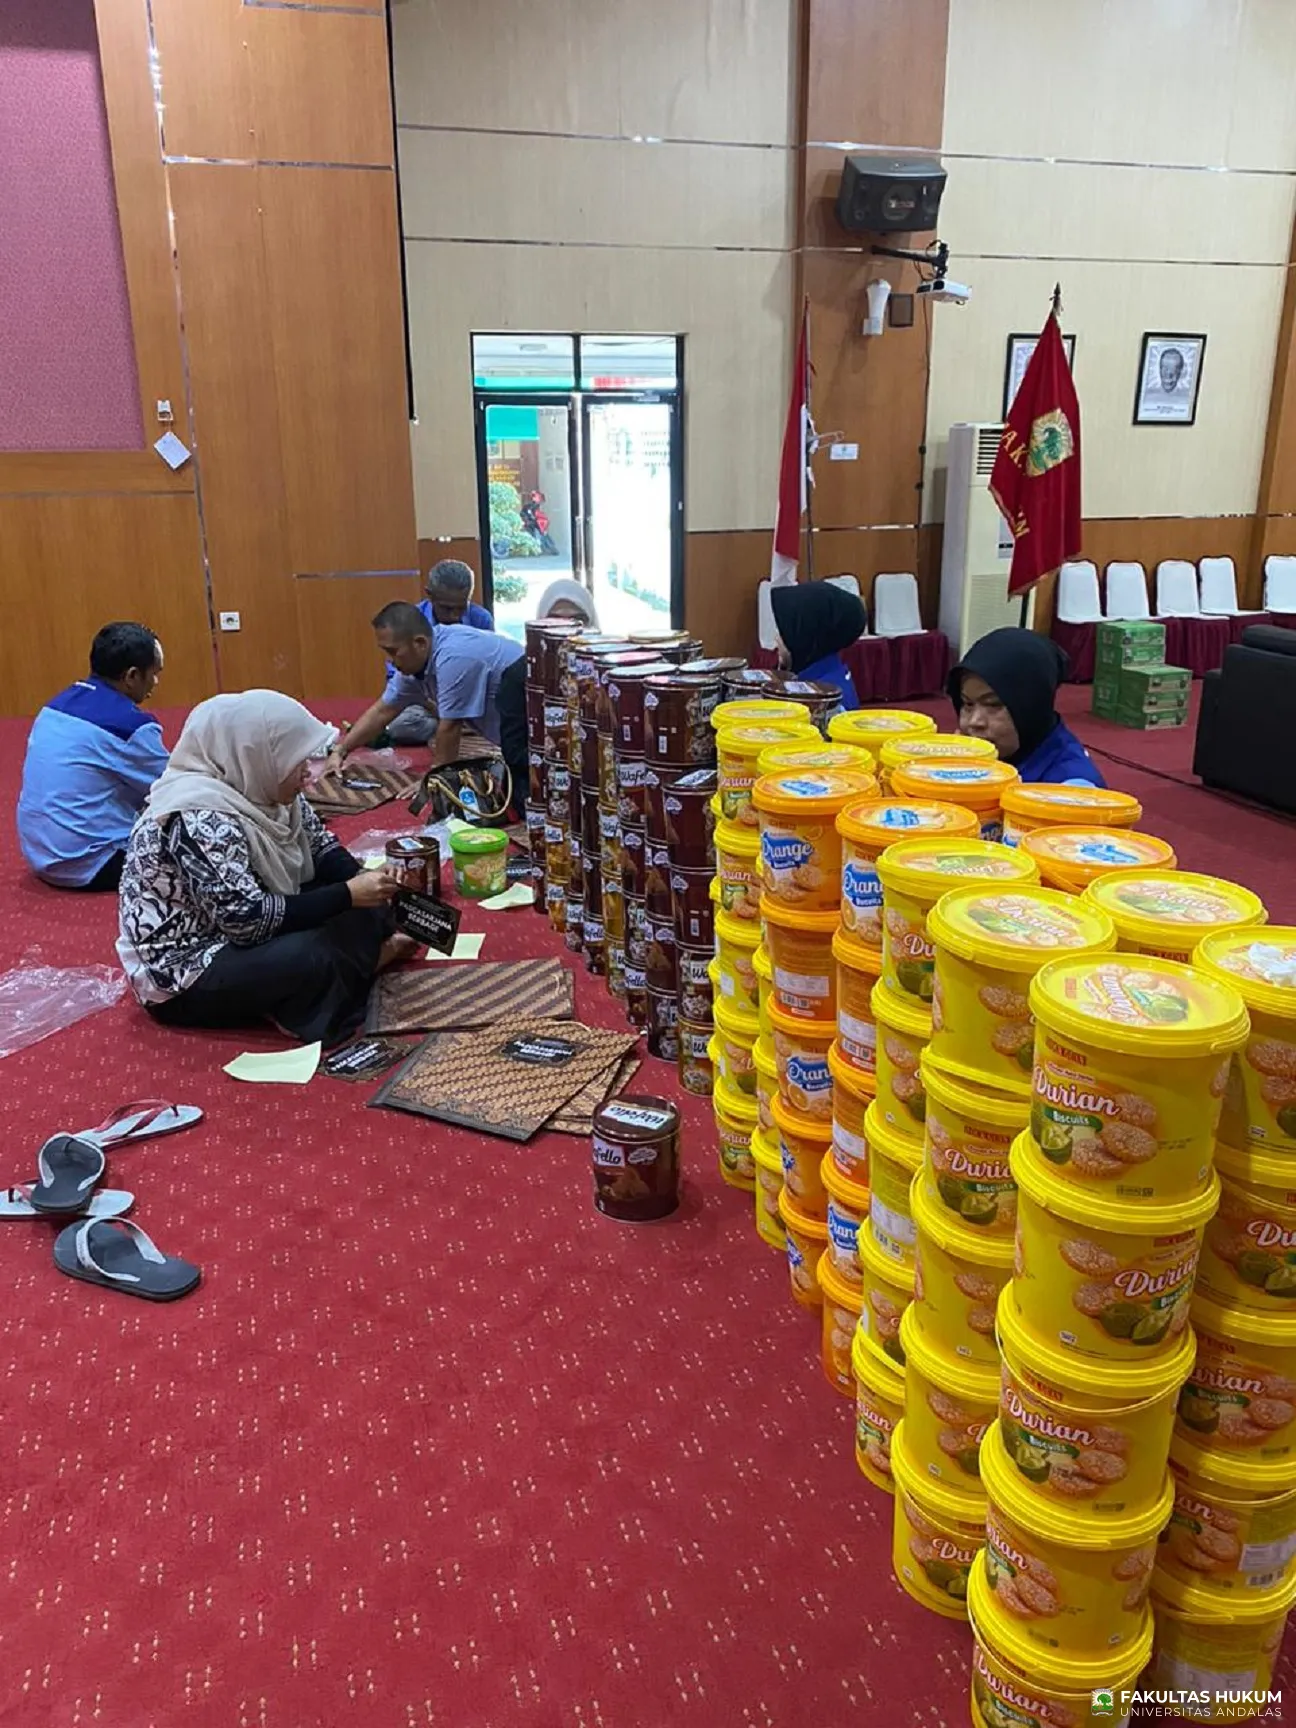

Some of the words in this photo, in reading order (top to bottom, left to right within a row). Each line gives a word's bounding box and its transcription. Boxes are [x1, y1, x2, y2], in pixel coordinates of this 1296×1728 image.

[763, 837, 813, 861] Orange
[844, 870, 884, 894] Oran
[1034, 1065, 1121, 1116] Durian
[1192, 1366, 1266, 1395] urian
[1005, 1388, 1097, 1446] Durian
